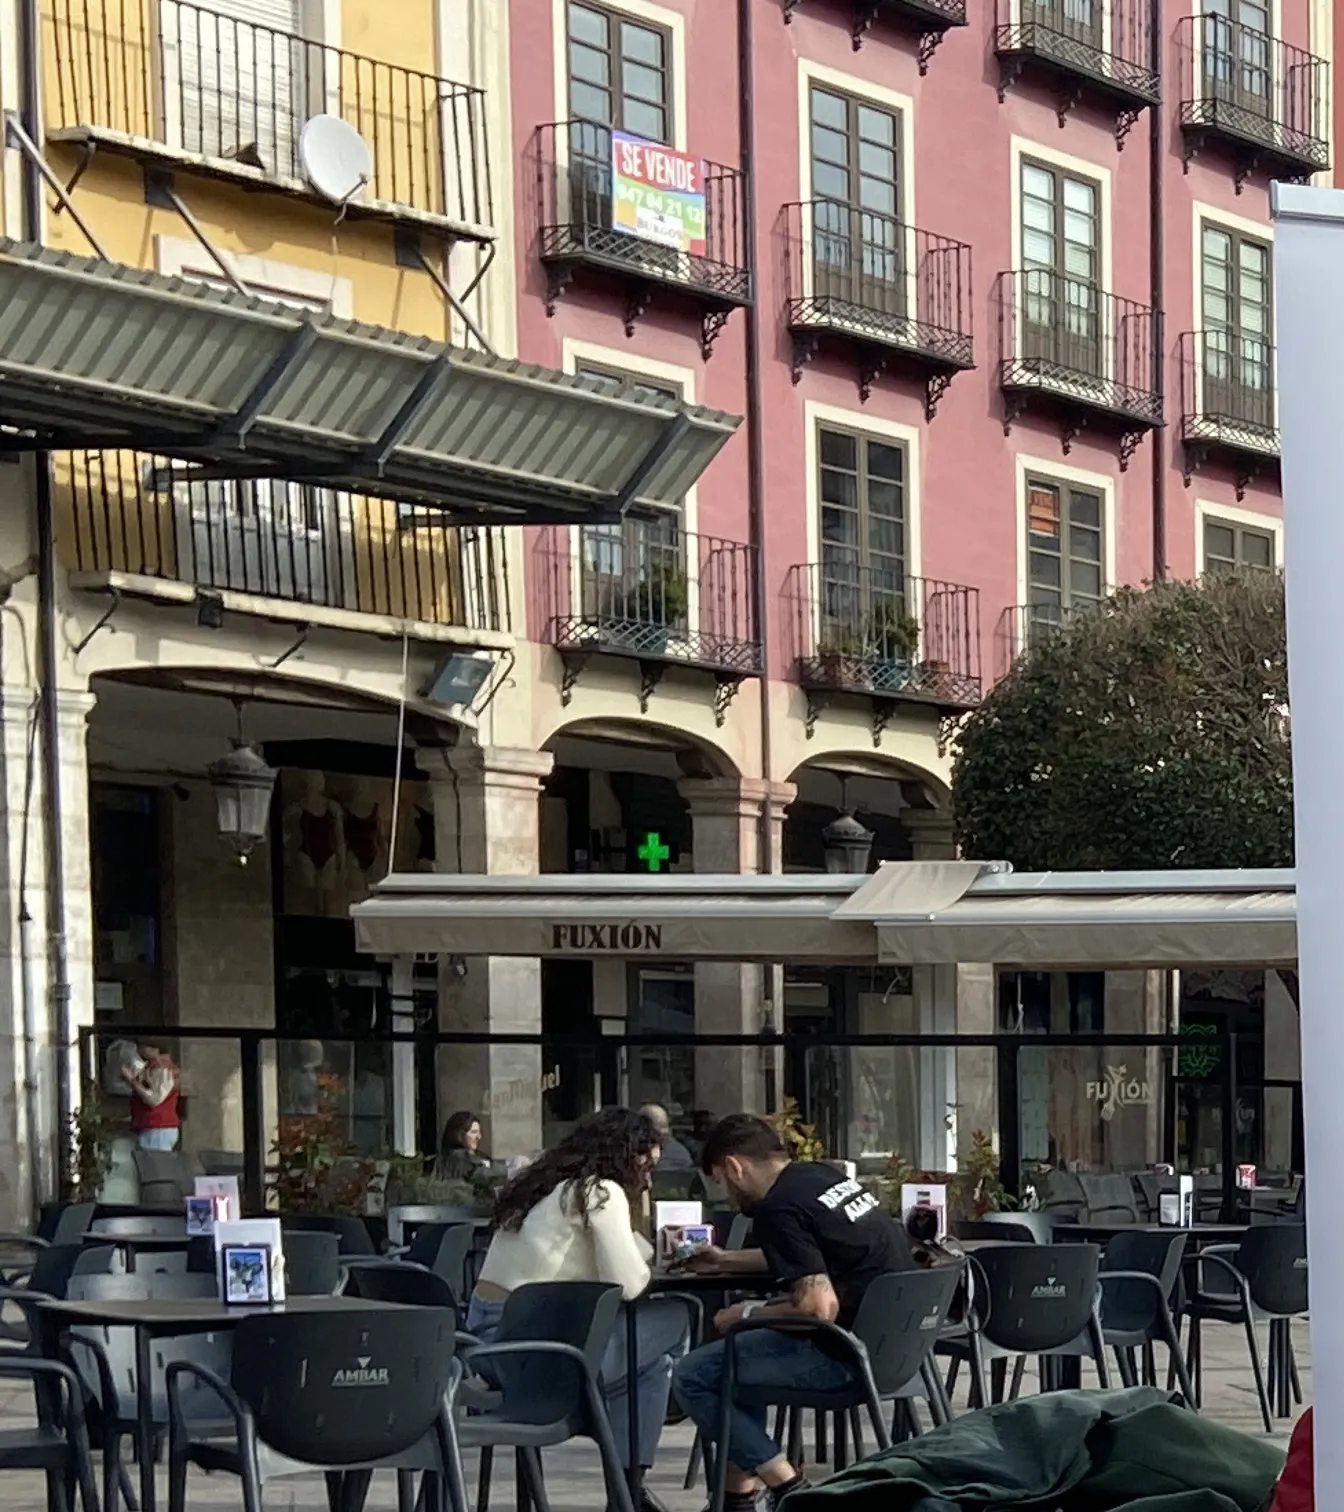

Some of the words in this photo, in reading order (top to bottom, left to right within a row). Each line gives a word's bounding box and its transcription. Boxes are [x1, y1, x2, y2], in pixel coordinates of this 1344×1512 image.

[621, 142, 642, 177] SE
[644, 148, 696, 193] VENDE
[551, 918, 662, 950] FUXIÓN
